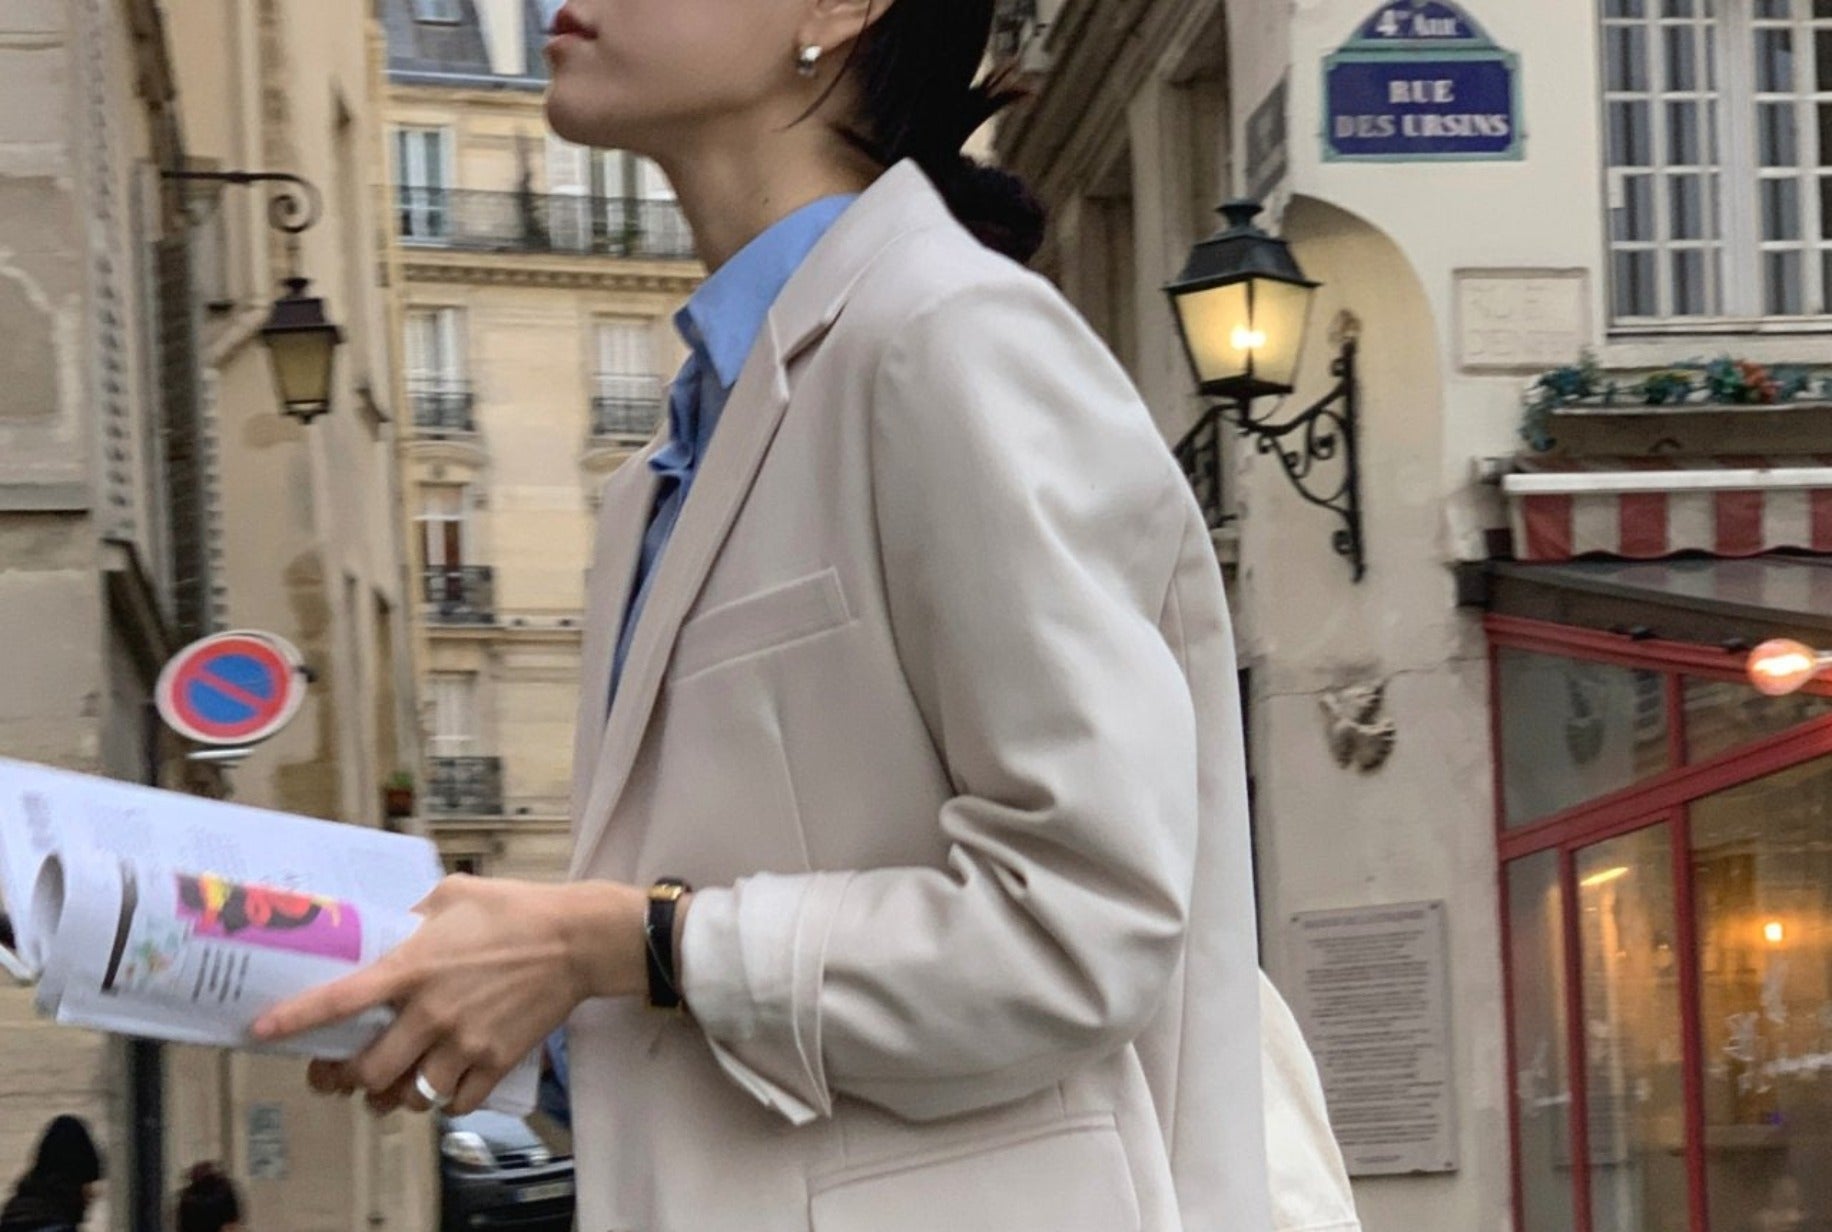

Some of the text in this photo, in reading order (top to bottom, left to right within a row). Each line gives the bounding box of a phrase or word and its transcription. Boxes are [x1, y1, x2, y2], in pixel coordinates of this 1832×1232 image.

[1388, 80, 1454, 103] RUE
[1335, 114, 1508, 138] DES URSINS
